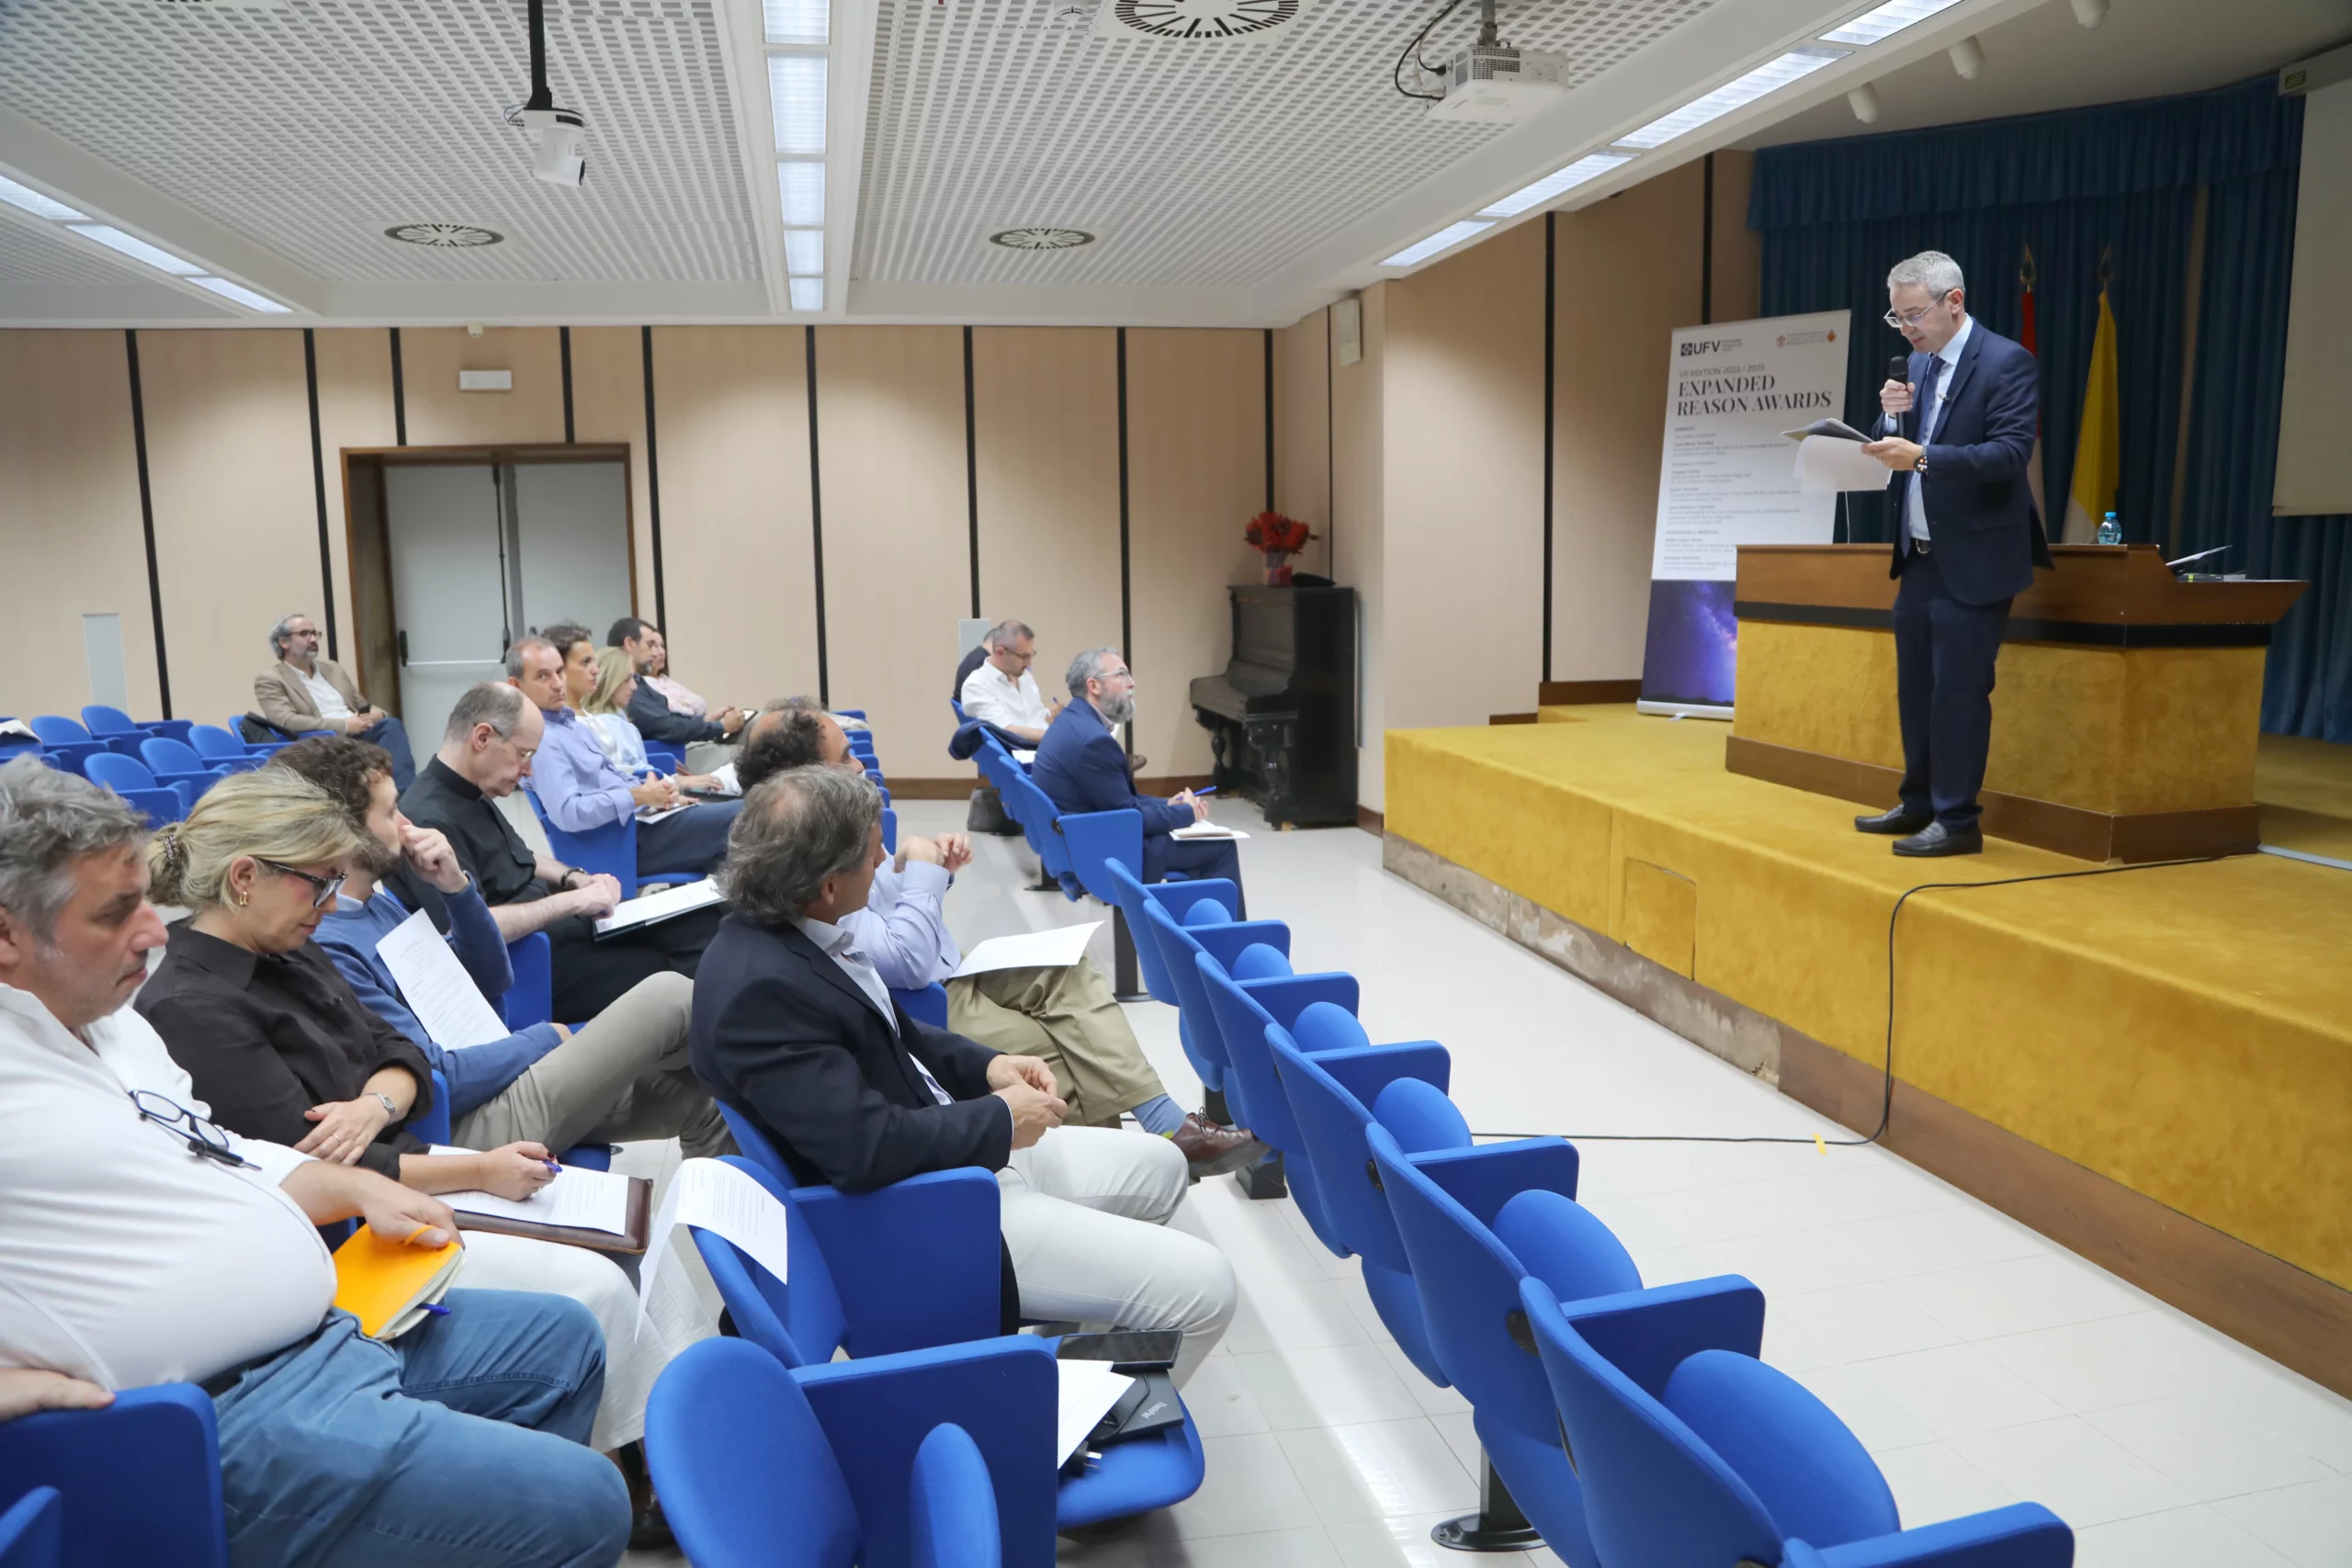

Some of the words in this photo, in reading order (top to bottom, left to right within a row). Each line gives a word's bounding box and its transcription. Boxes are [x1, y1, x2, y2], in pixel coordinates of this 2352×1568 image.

[1693, 340, 1721, 355] UFV
[1690, 367, 1721, 378] EDITION
[1679, 375, 1775, 398] EXPANDED
[1677, 396, 1747, 417] REASON
[1752, 390, 1832, 412] AWARDS
